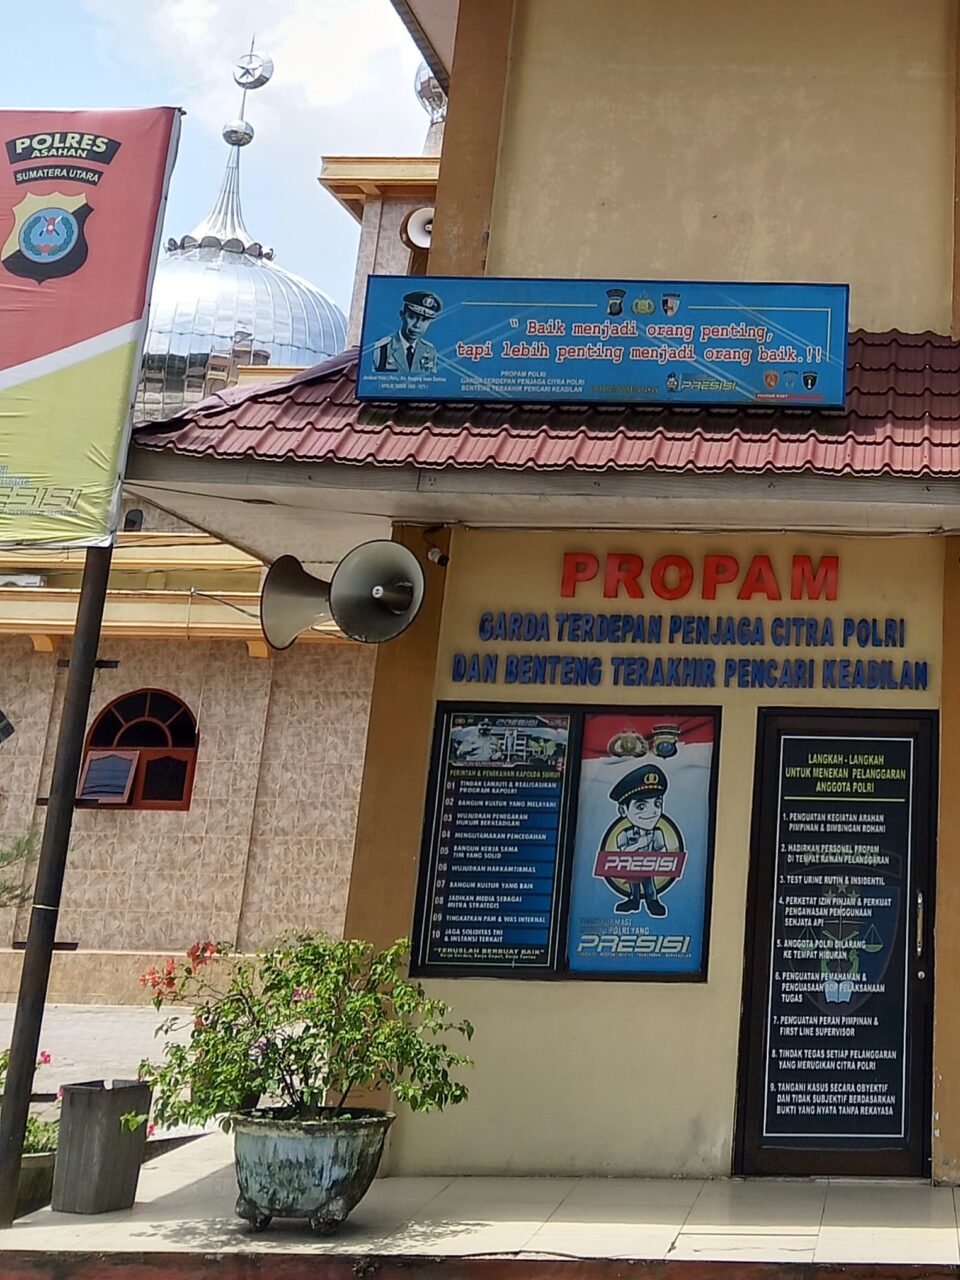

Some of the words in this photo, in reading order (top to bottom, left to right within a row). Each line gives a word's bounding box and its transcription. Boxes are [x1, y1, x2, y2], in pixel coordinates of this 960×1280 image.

[16, 133, 109, 153] POLRES
[31, 149, 87, 158] ASAHAN
[16, 169, 67, 181] SUMATERA
[69, 169, 99, 182] UTARA
[526, 320, 565, 336] Baik
[573, 321, 637, 339] menjadi
[646, 324, 694, 340] orang
[701, 323, 773, 343] penting,
[456, 341, 493, 361] tapi
[502, 342, 549, 360] lebih
[556, 343, 624, 363] penting
[631, 346, 695, 365] menjadi
[704, 348, 752, 365] orang
[681, 381, 737, 393] PRESISI
[560, 552, 839, 601] PROPAM
[479, 612, 550, 642] GARDA
[556, 613, 663, 644] TERDEPAN
[669, 615, 764, 646] PENJAGA
[771, 617, 834, 647] CITRA
[843, 618, 905, 648] POLRI
[452, 653, 498, 683] DAN
[505, 655, 602, 686] BENTENG
[611, 656, 716, 687] TERAKHIR
[724, 658, 814, 689] PENCARI
[823, 660, 928, 691] KEADILAN
[808, 754, 843, 764] LANGKAH
[849, 755, 884, 765] LANGKAH
[786, 767, 811, 777] UNTUK
[813, 768, 848, 778] MENEKAN
[852, 769, 906, 779] PELANGGARAN
[816, 782, 851, 792] ANGGOTA
[853, 783, 874, 793] POLRI
[789, 813, 825, 821] PENGUATAN
[827, 814, 857, 822] KEGIATAN
[859, 814, 884, 822] ARAHAN
[789, 823, 818, 831] PIMPINAN
[827, 824, 861, 832] BIMBINGAN
[781, 844, 786, 852] 2.
[788, 844, 820, 852] HADIRKAN
[821, 845, 853, 853] PERSONEL
[855, 845, 879, 853] PROPAM
[604, 856, 678, 871] PRESISI
[796, 855, 819, 863] TEMPAT
[844, 856, 889, 864] PELANGGARAN
[804, 876, 822, 884] URINE
[824, 876, 843, 884] RUTIN
[851, 877, 885, 885] INSIDENTIL
[786, 897, 816, 905] PERKETAT
[833, 898, 855, 906] PINJAM
[785, 908, 827, 916] PENGAWASAN
[829, 908, 872, 916] PENGGUNAAN
[785, 918, 812, 926] SENJATA
[814, 918, 824, 926] API
[631, 927, 649, 935] YANG
[578, 935, 690, 953] PRESISI
[777, 939, 782, 947] 5.
[784, 940, 813, 948] ANGGOTA
[815, 940, 833, 948] POLRI
[835, 940, 866, 949] DILARANG
[783, 950, 792, 958] KE
[794, 951, 817, 959] TEMPAT
[819, 951, 847, 959] HIBURAN
[775, 972, 780, 980] 6.
[783, 972, 819, 980] PENGUATAN
[821, 973, 860, 981] PEMAHAMAN
[862, 973, 866, 981] &
[782, 983, 823, 991] PENGUASAAN
[840, 984, 885, 992] PELAKSANAAN
[781, 994, 802, 1002] TUGAS
[774, 1016, 779, 1024] 7.
[781, 1016, 817, 1024] PENGUATAN
[842, 1017, 872, 1025] PIMPINAN
[874, 1017, 878, 1025] &
[780, 1027, 798, 1036] FIRST
[800, 1028, 813, 1036] LINE
[816, 1028, 855, 1036] SUPERVISOR
[772, 1049, 777, 1057] 8.
[779, 1050, 802, 1058] TINDAK
[804, 1050, 824, 1058] TEGAS
[826, 1050, 848, 1058] SETIAP
[850, 1050, 896, 1059] PELANGGARAN
[779, 1060, 795, 1069] YANG
[797, 1061, 835, 1069] MERUGIKAN
[837, 1061, 855, 1069] CITRA
[857, 1062, 876, 1070] POLRI
[770, 1083, 776, 1091] 9.
[778, 1083, 805, 1091] TANGANI
[807, 1083, 828, 1092] KASUS
[830, 1083, 855, 1092] SECARA
[857, 1084, 888, 1092] OBYEKTIF
[777, 1095, 790, 1103] DAN
[792, 1095, 811, 1103] TIDAK
[813, 1095, 847, 1103] SUBJEKTIF
[849, 1095, 895, 1103] BERDASARKAN
[777, 1106, 796, 1114] BUKTI
[798, 1106, 815, 1114] YANG
[817, 1106, 837, 1114] NYATA
[839, 1106, 858, 1114] TANPA
[861, 1106, 893, 1115] REKAYASA
